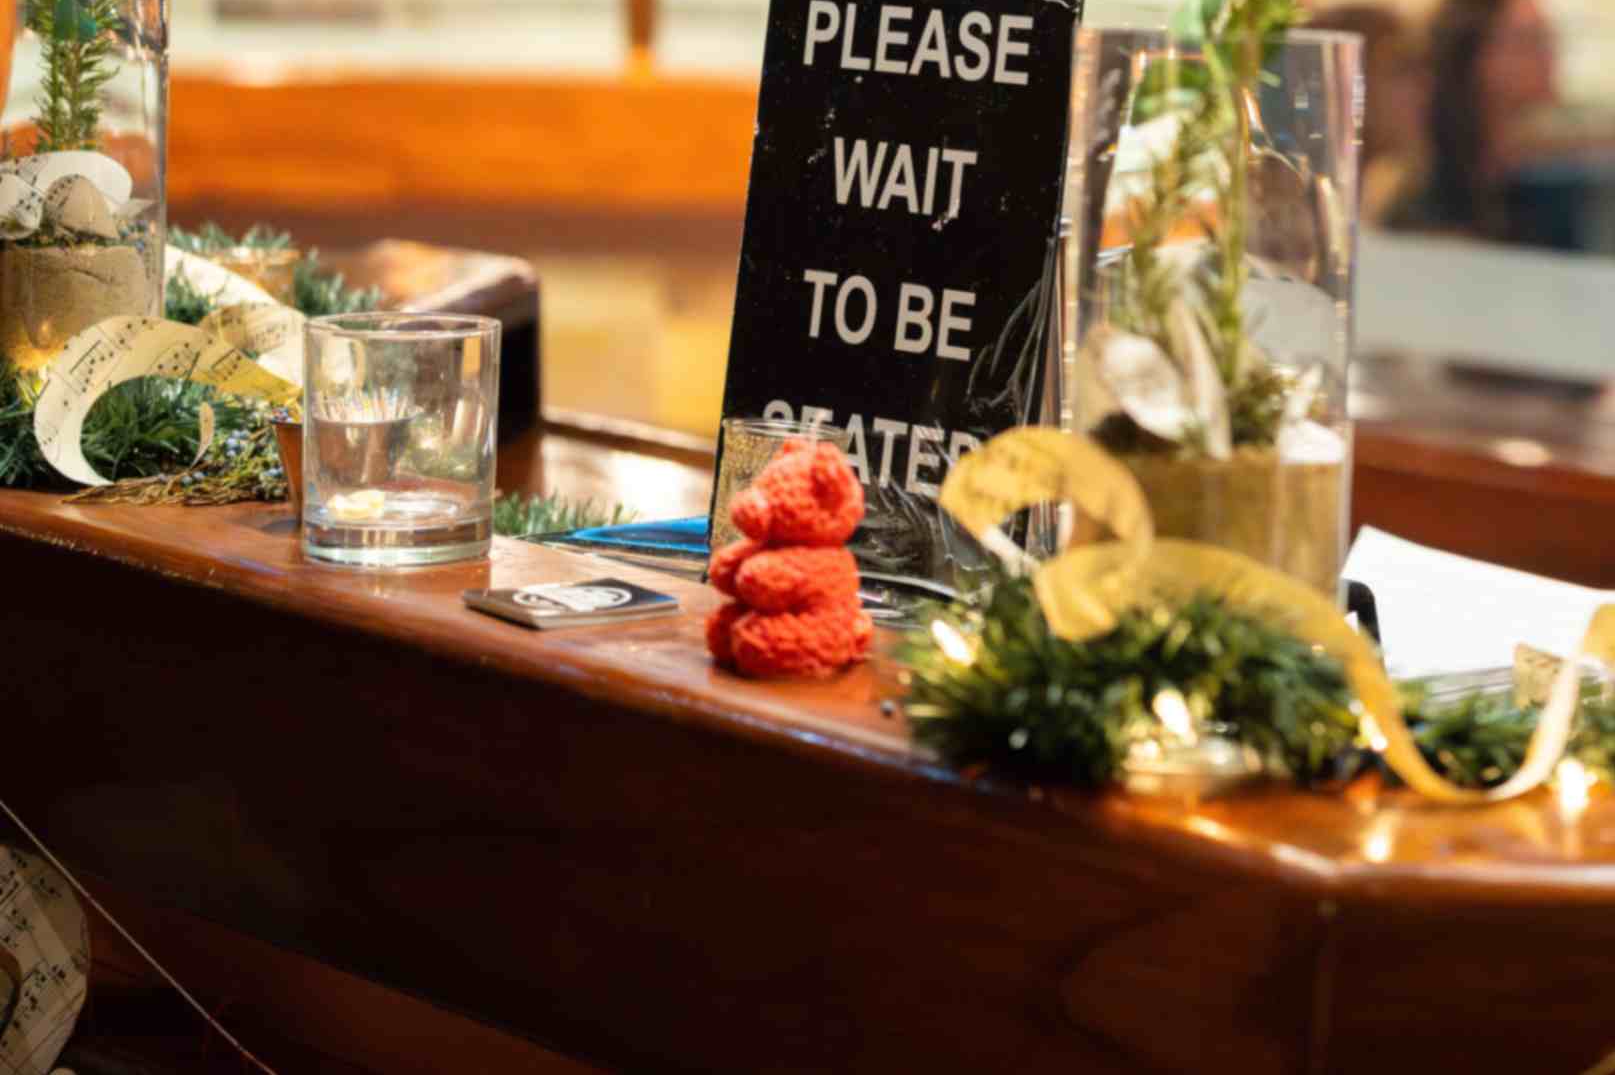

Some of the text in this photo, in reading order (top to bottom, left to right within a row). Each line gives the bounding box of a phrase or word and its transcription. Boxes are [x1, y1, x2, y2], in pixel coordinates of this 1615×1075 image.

[803, 0, 1034, 85] PLEASE
[834, 137, 977, 220] WAIT
[804, 269, 976, 361] TO BE
